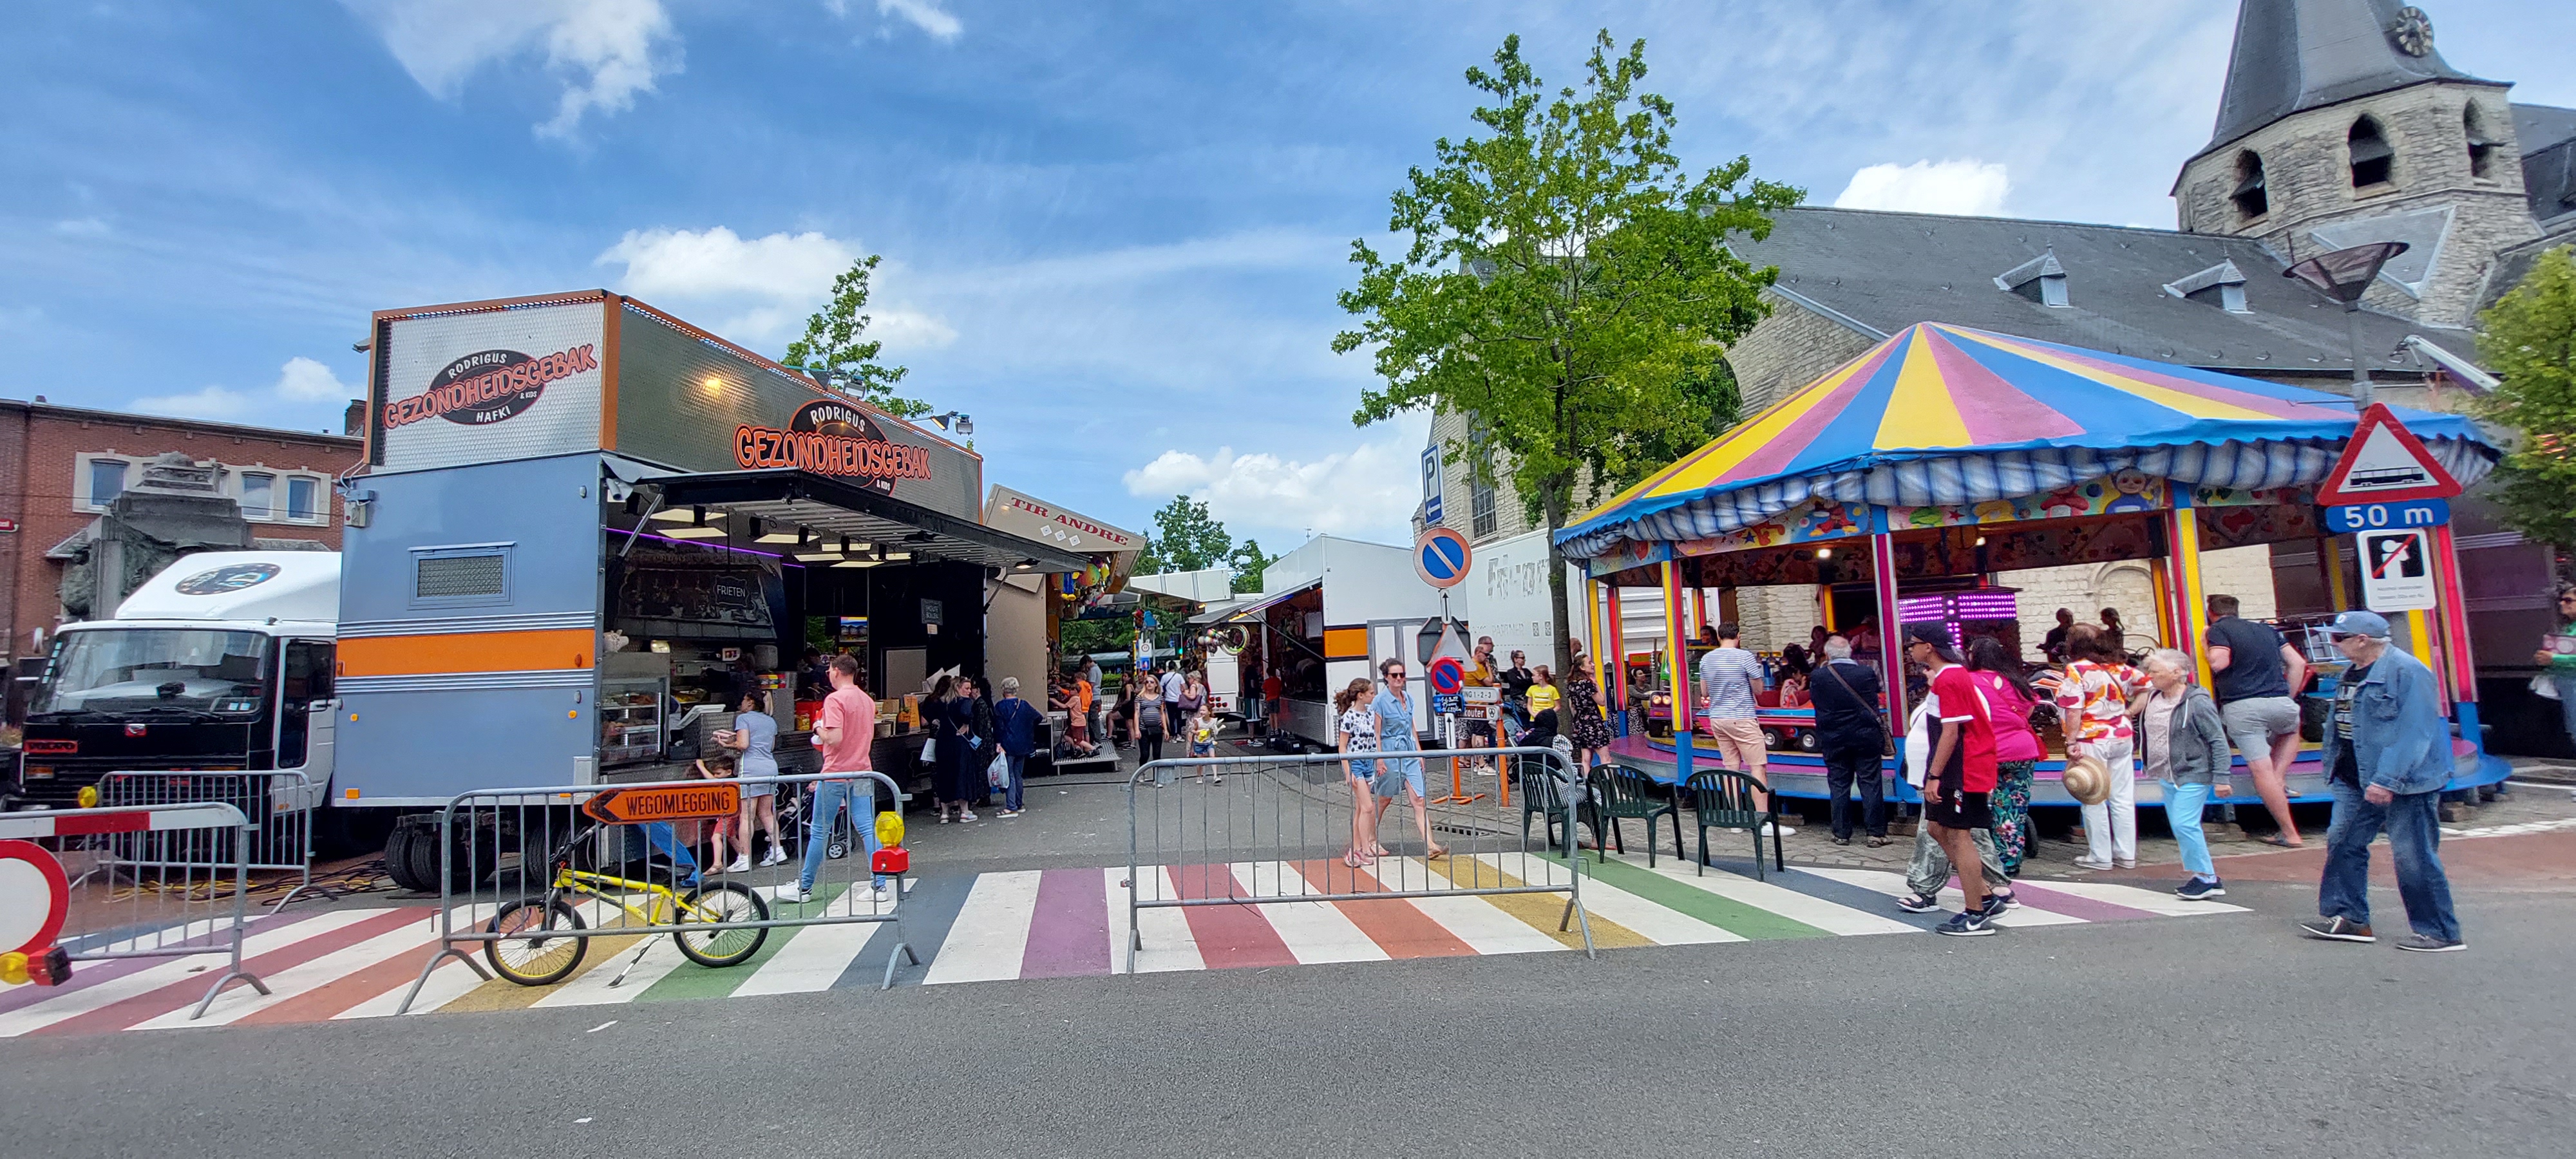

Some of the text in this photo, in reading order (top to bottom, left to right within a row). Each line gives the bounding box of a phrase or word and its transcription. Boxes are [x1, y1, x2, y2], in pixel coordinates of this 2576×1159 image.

[448, 353, 507, 379] RODRIGUS
[383, 344, 598, 429] GEZONDHEIDSGEBAK
[476, 405, 511, 423] HAFKI
[810, 406, 866, 432] RODRIGUS
[735, 424, 931, 480] GEZONDHEIDSGEBAK
[880, 481, 890, 491] KIDS
[1425, 455, 1435, 497] P
[1011, 497, 1128, 545] TIR ANDRE
[2345, 504, 2433, 528] 50 m
[717, 585, 746, 598] FRIETEN
[626, 791, 730, 816] WEGOMLEGGING
